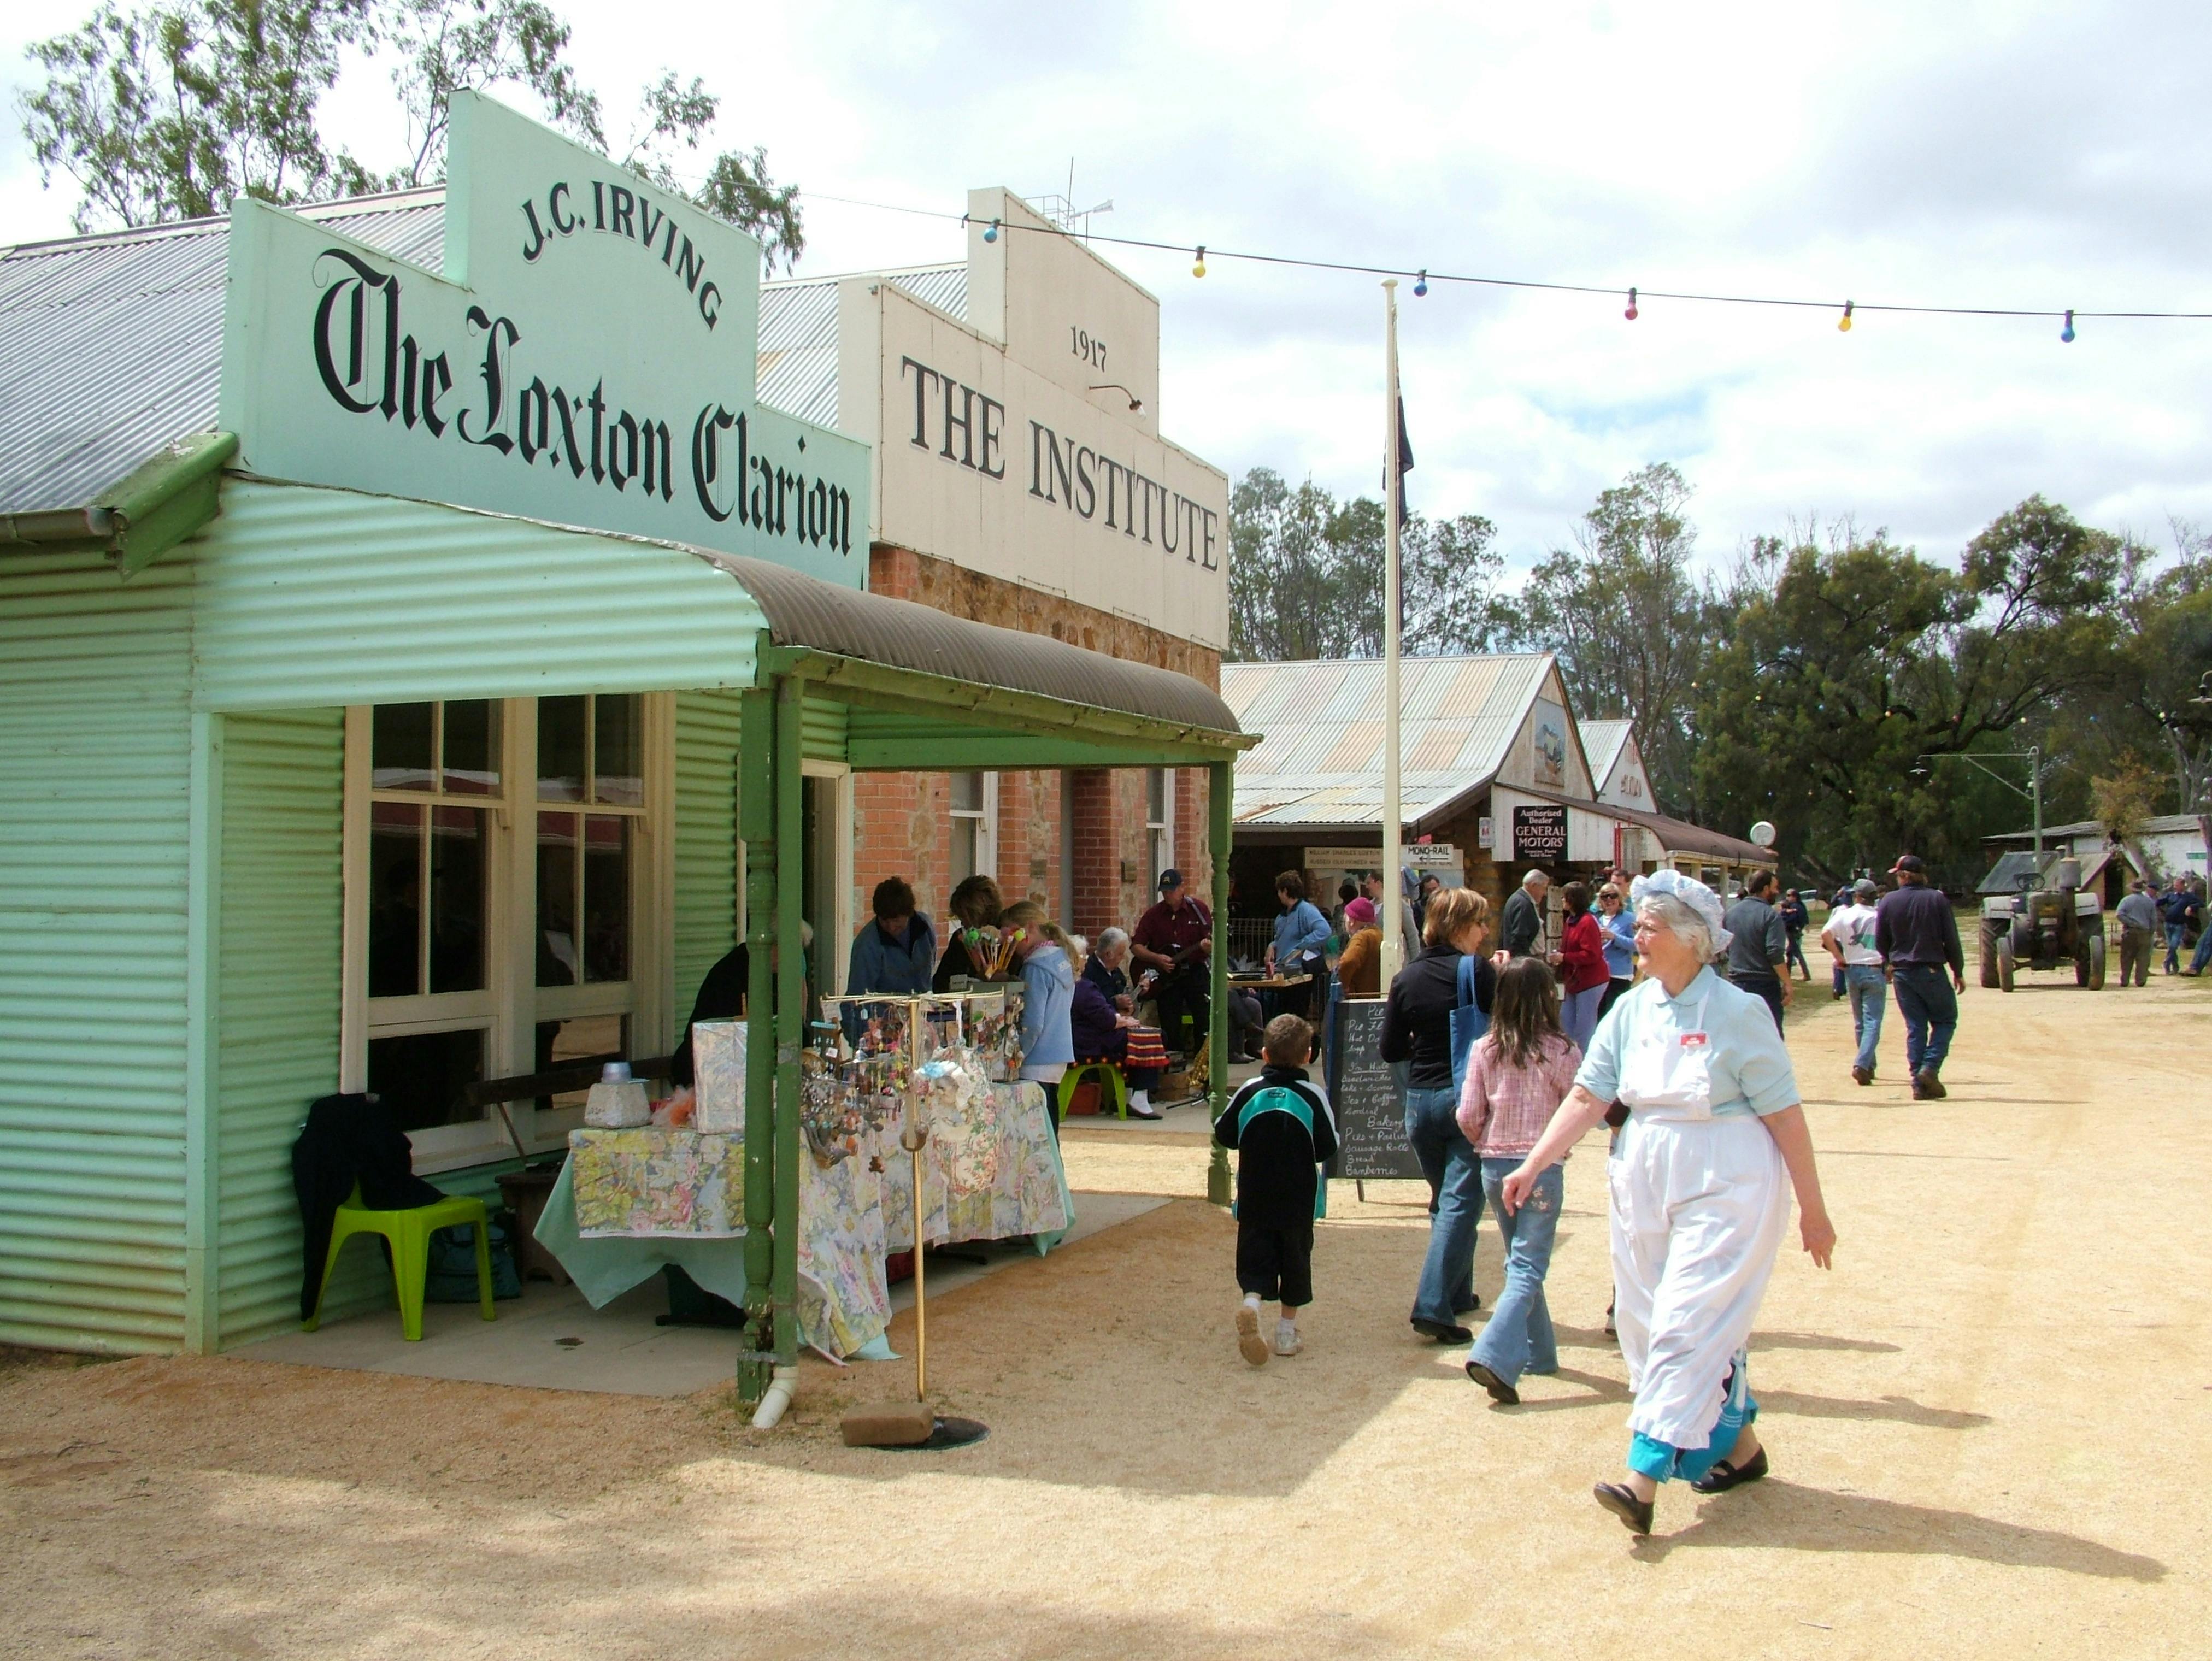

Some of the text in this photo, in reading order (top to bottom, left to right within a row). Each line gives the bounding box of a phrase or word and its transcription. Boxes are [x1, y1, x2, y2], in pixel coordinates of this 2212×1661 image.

[522, 180, 723, 332] J.C. IRVING
[1070, 325, 1107, 373] 1917
[312, 249, 852, 557] The Loxton Clarion
[902, 355, 1219, 573] THE INSTITUTE
[1515, 826, 1566, 836] GENERAL
[1518, 837, 1564, 847] MOTORS
[1408, 846, 1449, 855] MONO-RAIL
[1348, 1019, 1364, 1031] Pie
[1367, 1114, 1404, 1133] Bakery
[1345, 1127, 1366, 1142] Pies
[1345, 1142, 1409, 1155] Sausage Rolls
[1346, 1153, 1375, 1164] Bread
